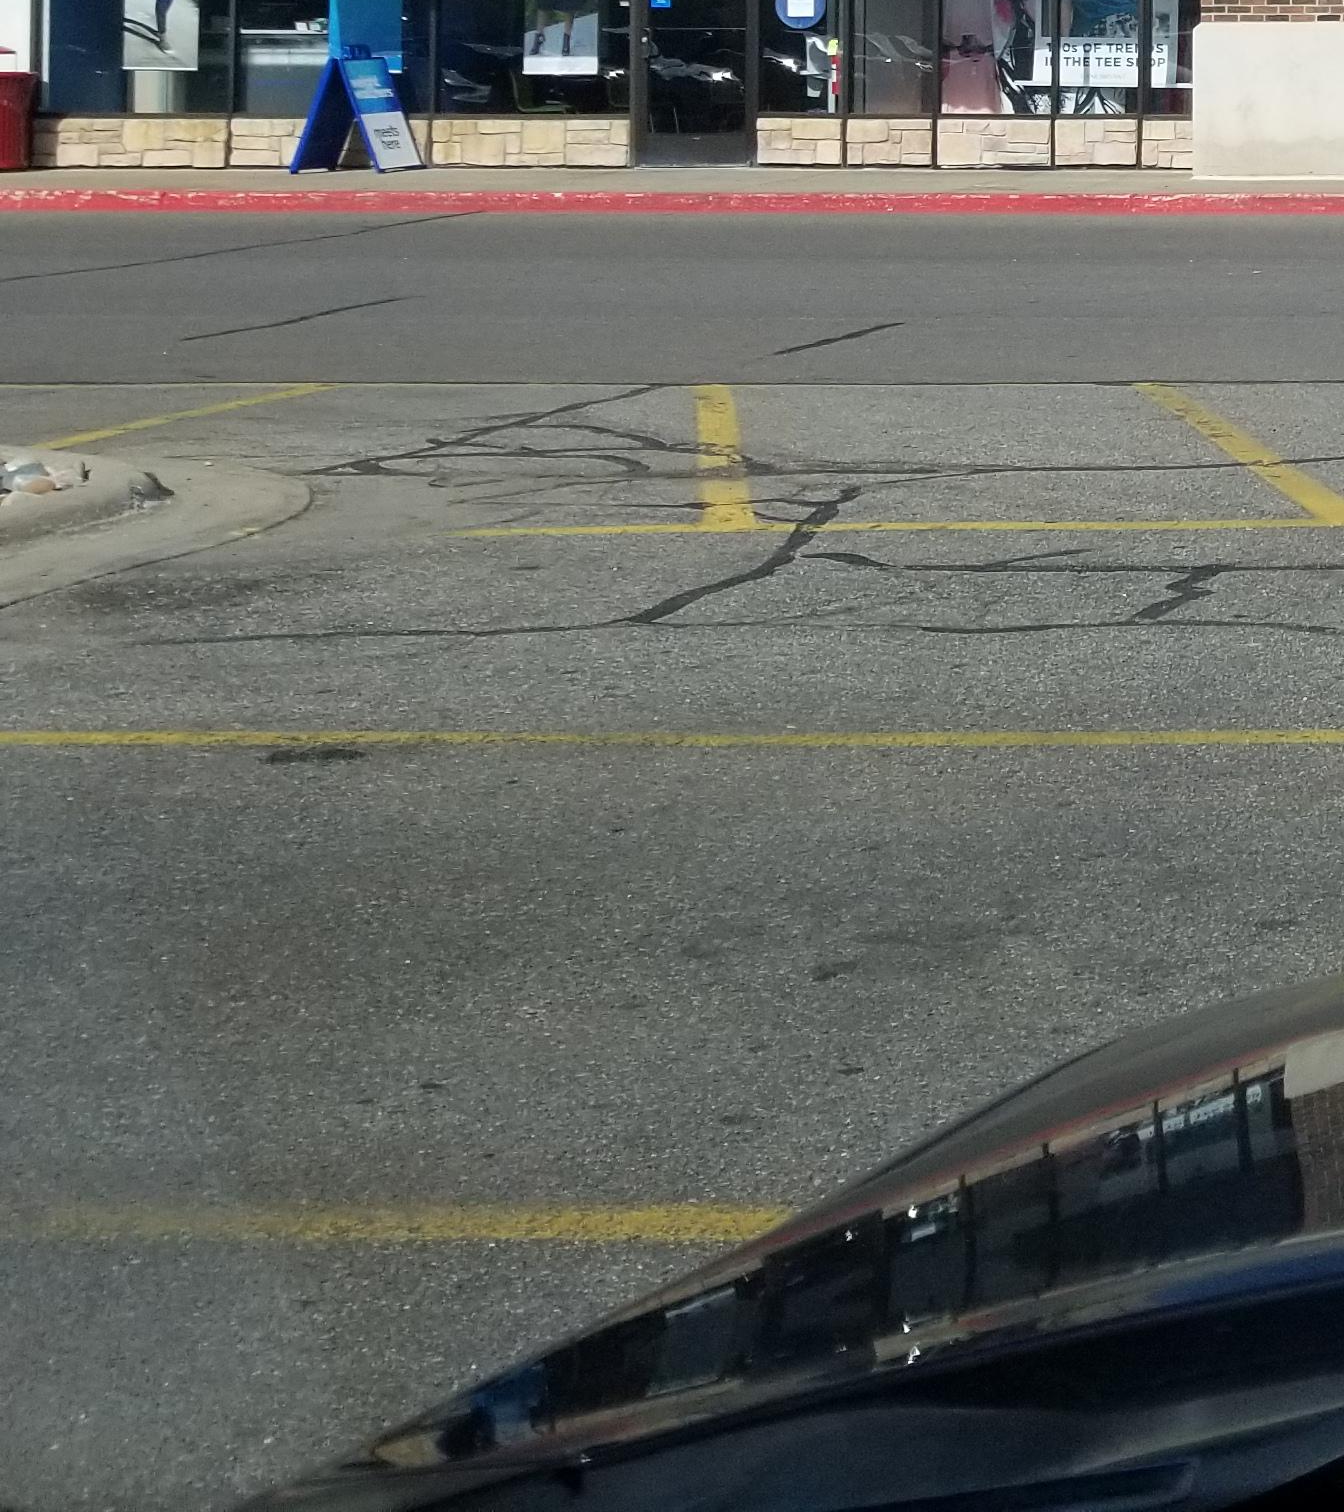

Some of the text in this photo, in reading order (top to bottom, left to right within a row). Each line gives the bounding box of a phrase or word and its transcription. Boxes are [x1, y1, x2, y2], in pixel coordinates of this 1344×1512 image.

[1047, 43, 1164, 54] 10s OF TRES
[1064, 57, 1090, 67] THE
[1096, 57, 1121, 67] TEE
[1126, 57, 1166, 67] SOP
